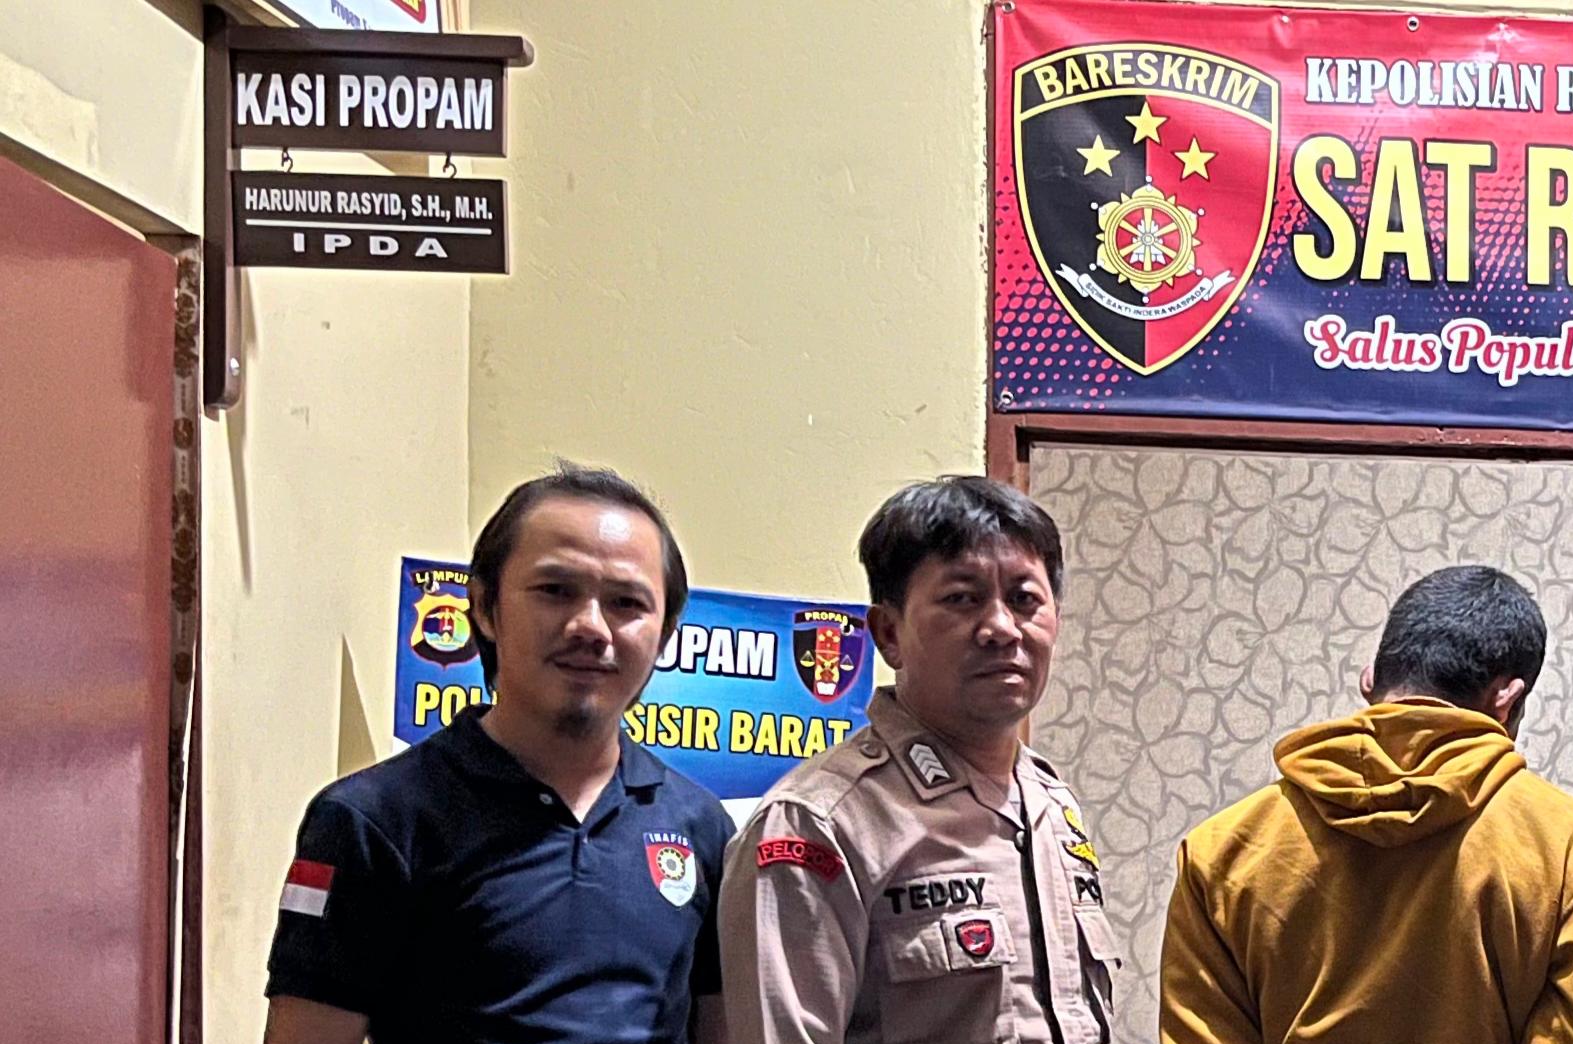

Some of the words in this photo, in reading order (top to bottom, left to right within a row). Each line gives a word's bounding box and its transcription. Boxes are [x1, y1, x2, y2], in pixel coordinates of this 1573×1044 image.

[236, 72, 326, 126] KASI
[338, 75, 494, 130] PROPAM
[1033, 50, 1261, 110] BARESKRIM
[1304, 57, 1544, 112] KEPOLISIAN
[244, 187, 333, 214] HARUNUR
[337, 192, 407, 221] RASYID,
[411, 194, 451, 223] S.H.,
[455, 196, 494, 221] M.H.
[1292, 135, 1493, 283] SAT
[1308, 319, 1438, 366] Salus
[623, 702, 719, 750] SISIR
[730, 711, 852, 759] BARAT
[883, 877, 986, 915] TEDDY
